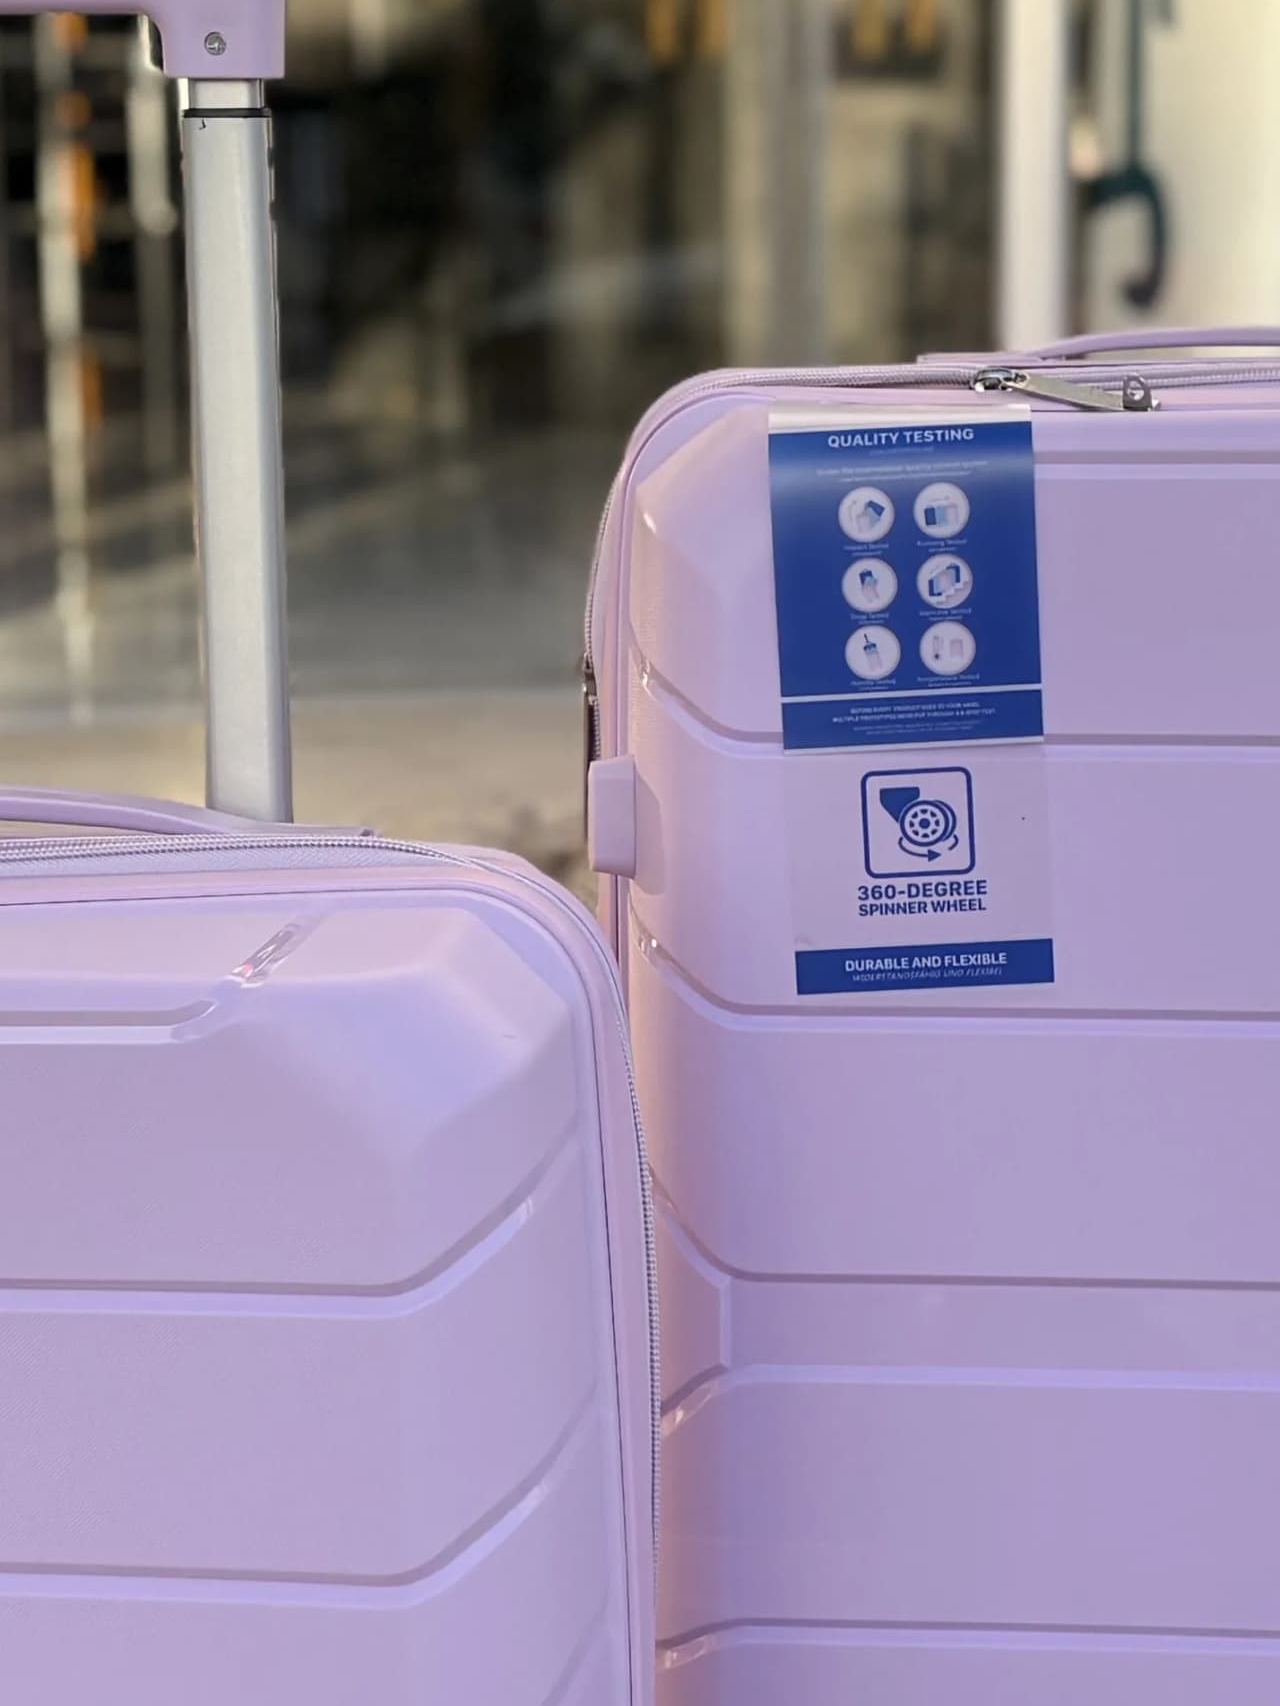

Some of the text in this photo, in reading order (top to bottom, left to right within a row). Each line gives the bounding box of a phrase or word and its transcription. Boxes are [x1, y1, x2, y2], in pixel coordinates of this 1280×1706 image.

[827, 428, 975, 448] QUALITY TESTING
[857, 880, 988, 901] 360-DEGREE
[859, 898, 987, 917] SPINNER WHEEL
[844, 952, 1008, 972] DURABLE AND FLEXIBLE
